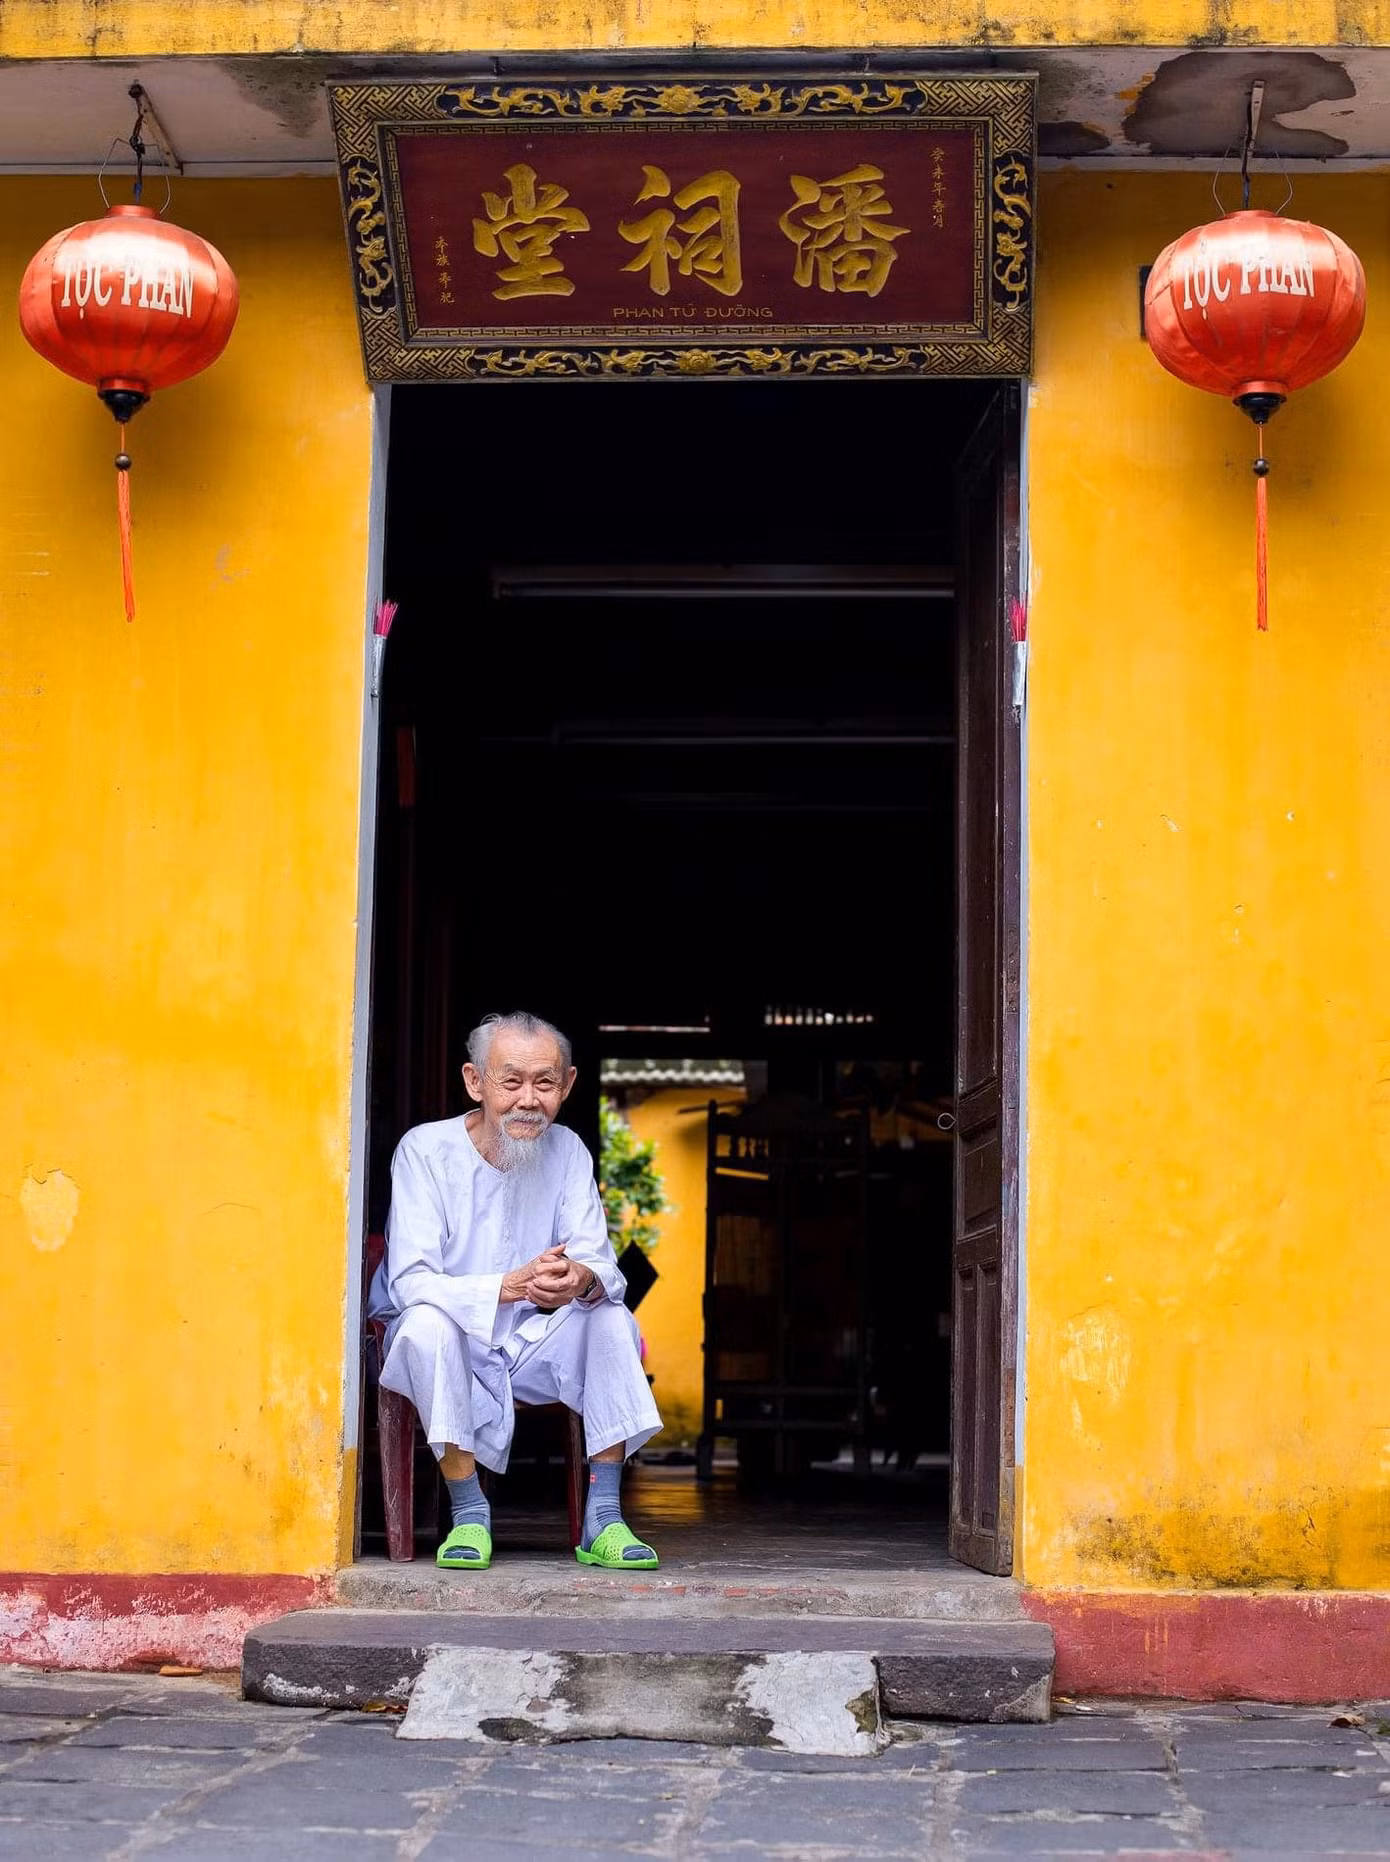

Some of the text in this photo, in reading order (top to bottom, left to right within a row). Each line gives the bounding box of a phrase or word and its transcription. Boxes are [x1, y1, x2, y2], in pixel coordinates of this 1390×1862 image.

[120, 255, 194, 319] PHAN
[1240, 254, 1315, 298] PHAN
[613, 307, 665, 318] PHAN
